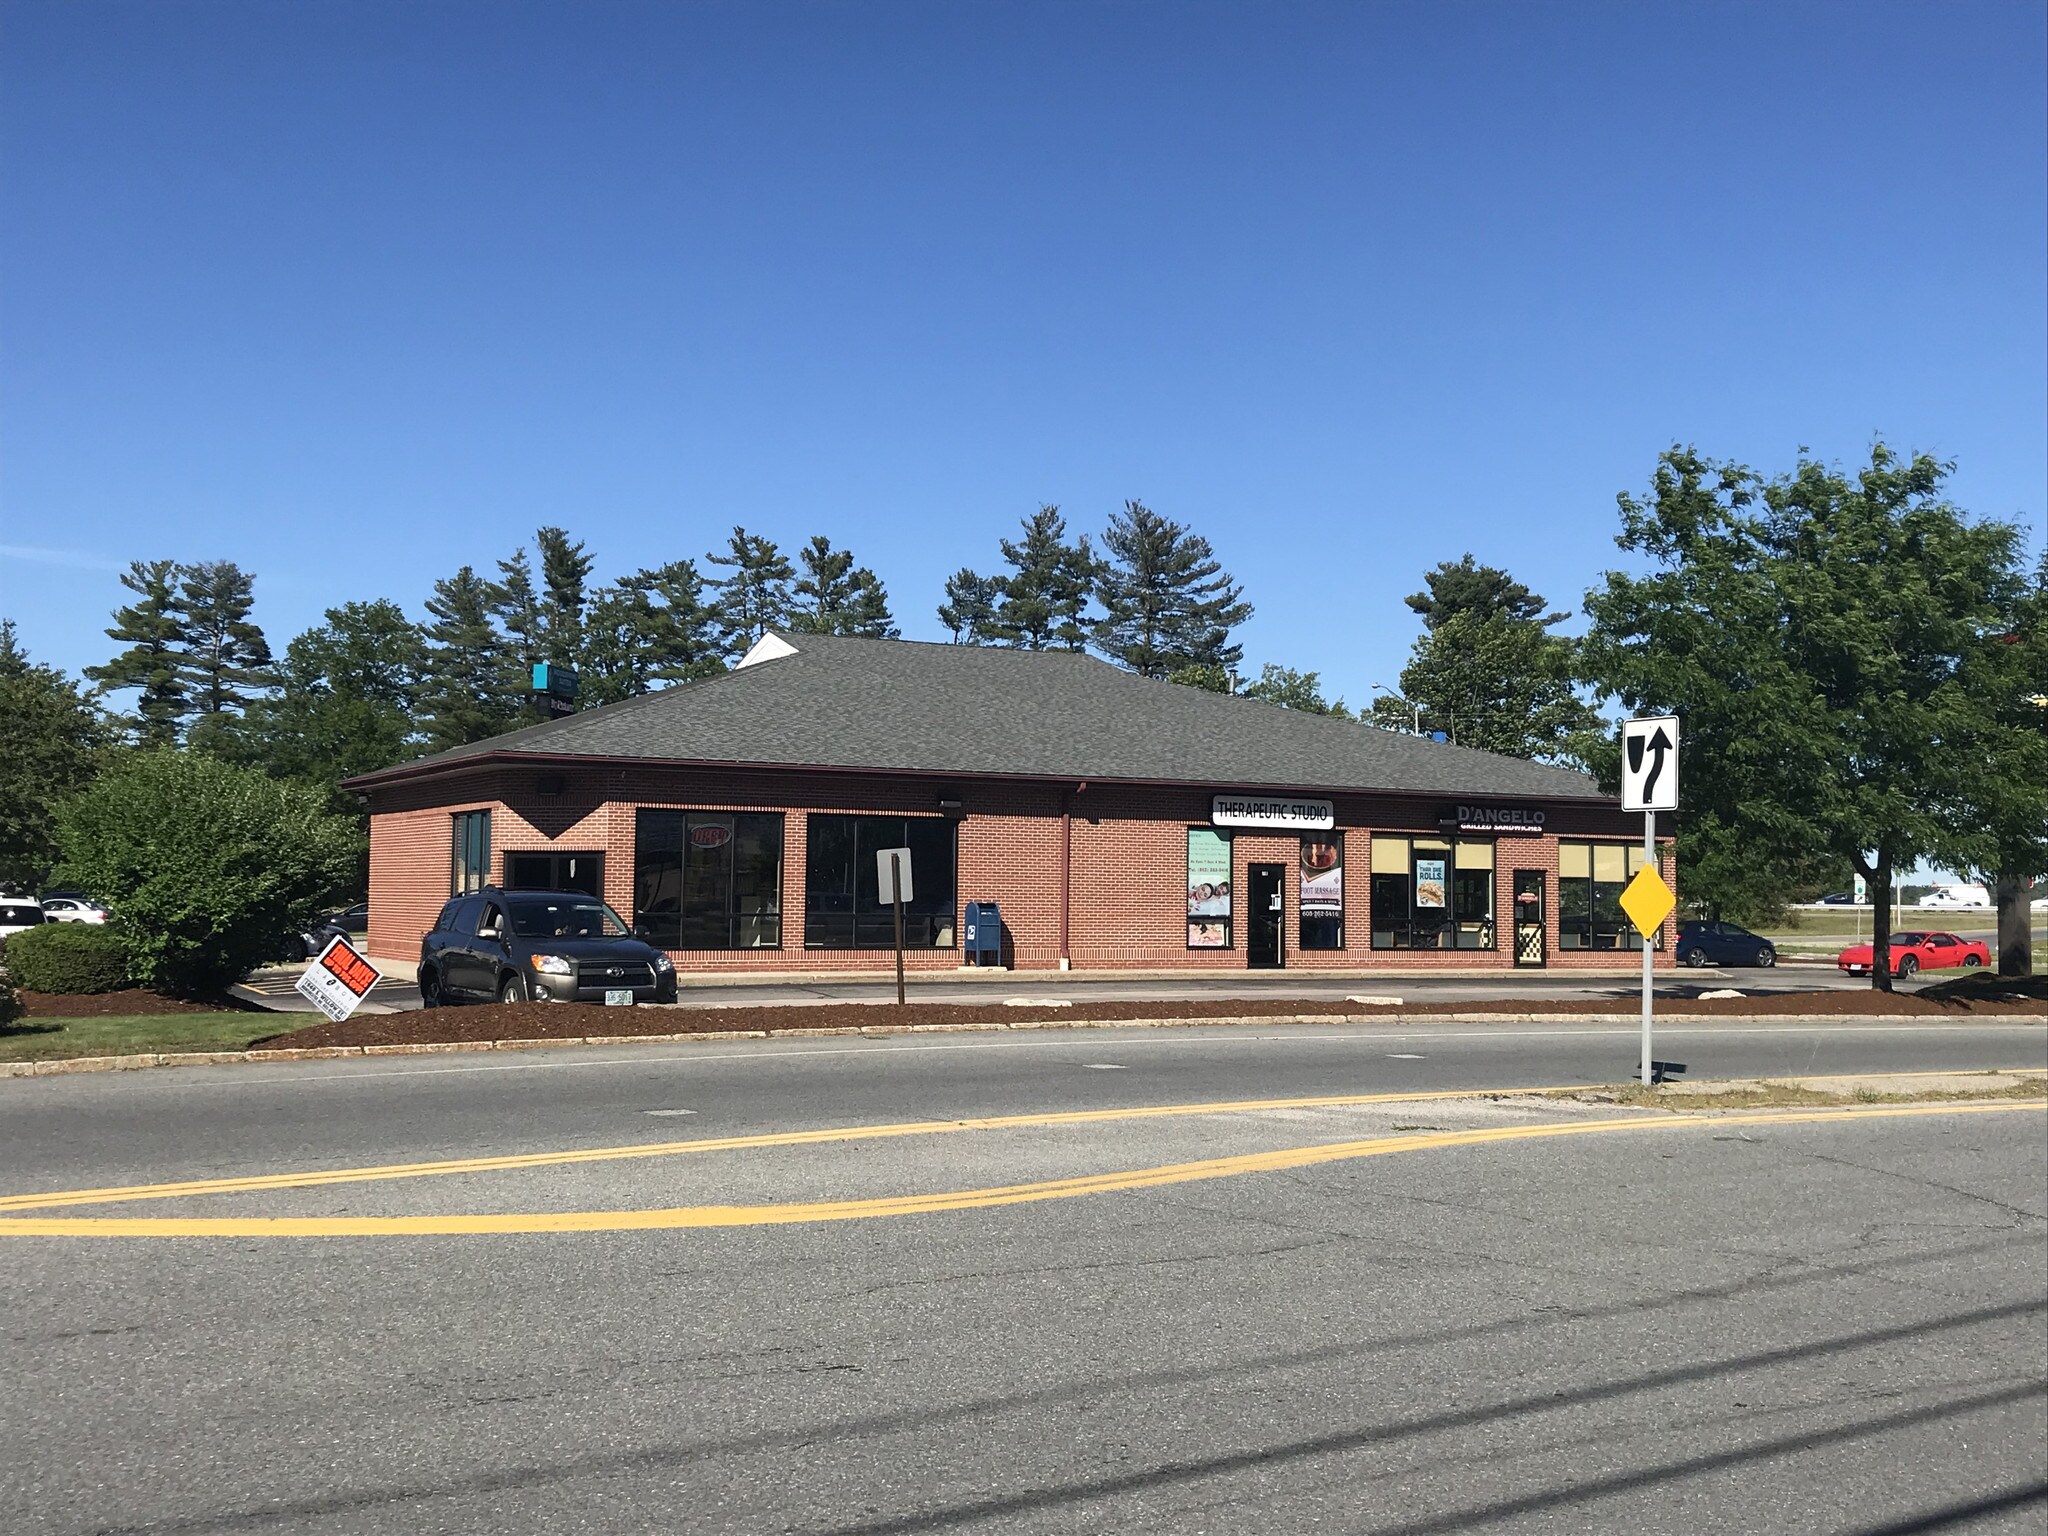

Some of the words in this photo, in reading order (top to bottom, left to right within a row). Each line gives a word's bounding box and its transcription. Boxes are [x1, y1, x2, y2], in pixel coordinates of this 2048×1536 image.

[1218, 801, 1287, 820] THERAPEUTIC
[1291, 804, 1328, 821] STUDIO
[1456, 805, 1545, 824] D'ANGELO
[1460, 822, 1492, 830] GRILLED
[1493, 823, 1543, 832] SANDWICHES
[1419, 872, 1443, 880] ROLLS.
[1314, 886, 1340, 895] MASSAGE
[329, 943, 356, 971] FINAL
[348, 960, 377, 988] DAYS!
[320, 994, 339, 1011] WILLOW
